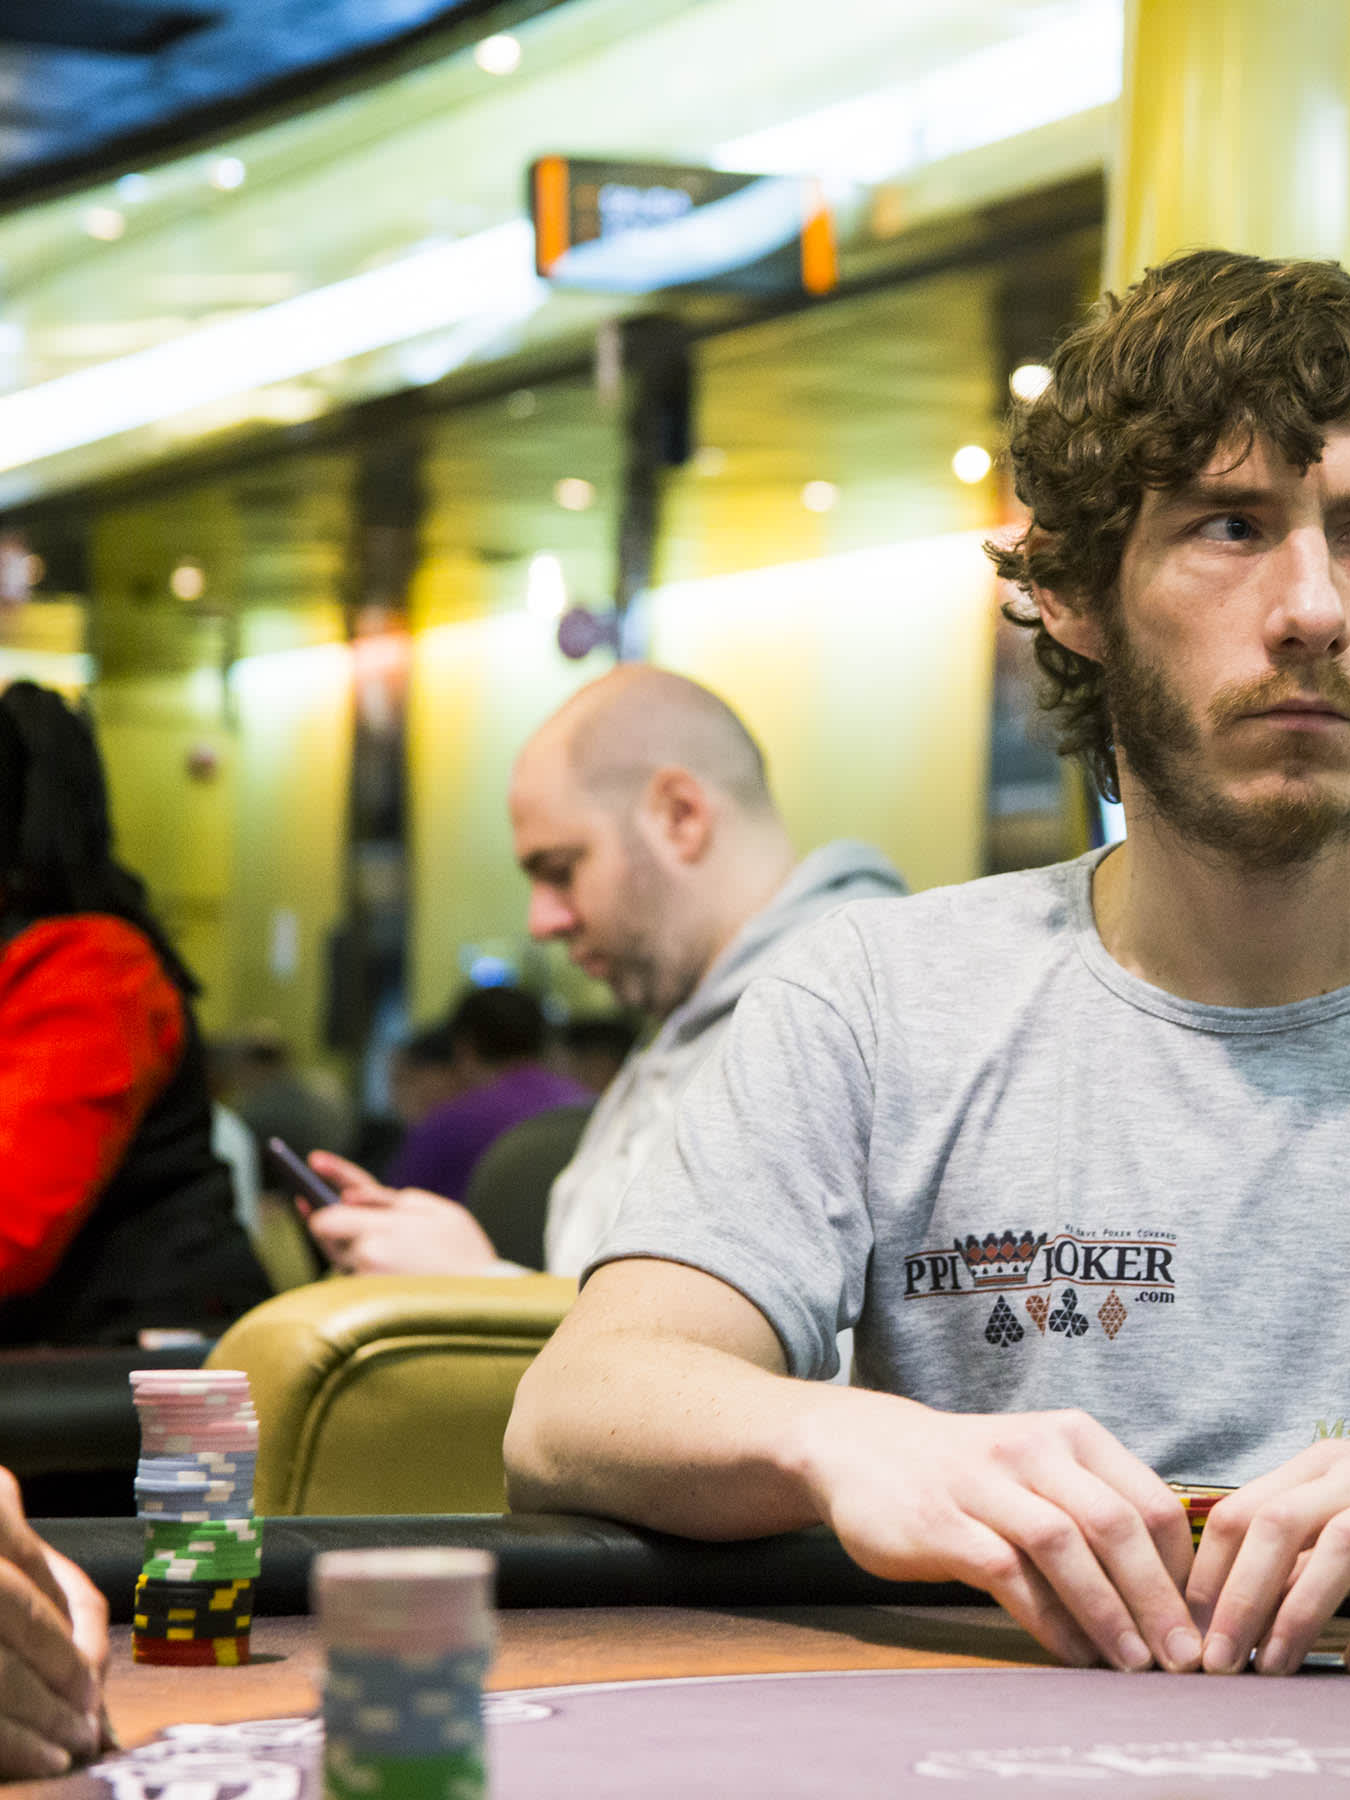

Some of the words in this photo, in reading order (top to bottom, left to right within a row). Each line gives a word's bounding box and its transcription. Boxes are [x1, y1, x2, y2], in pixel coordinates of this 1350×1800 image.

[1103, 1227, 1132, 1237] POKER
[1137, 1228, 1177, 1240] COVERED
[903, 1255, 962, 1295] PPI
[1134, 1290, 1176, 1304] .com
